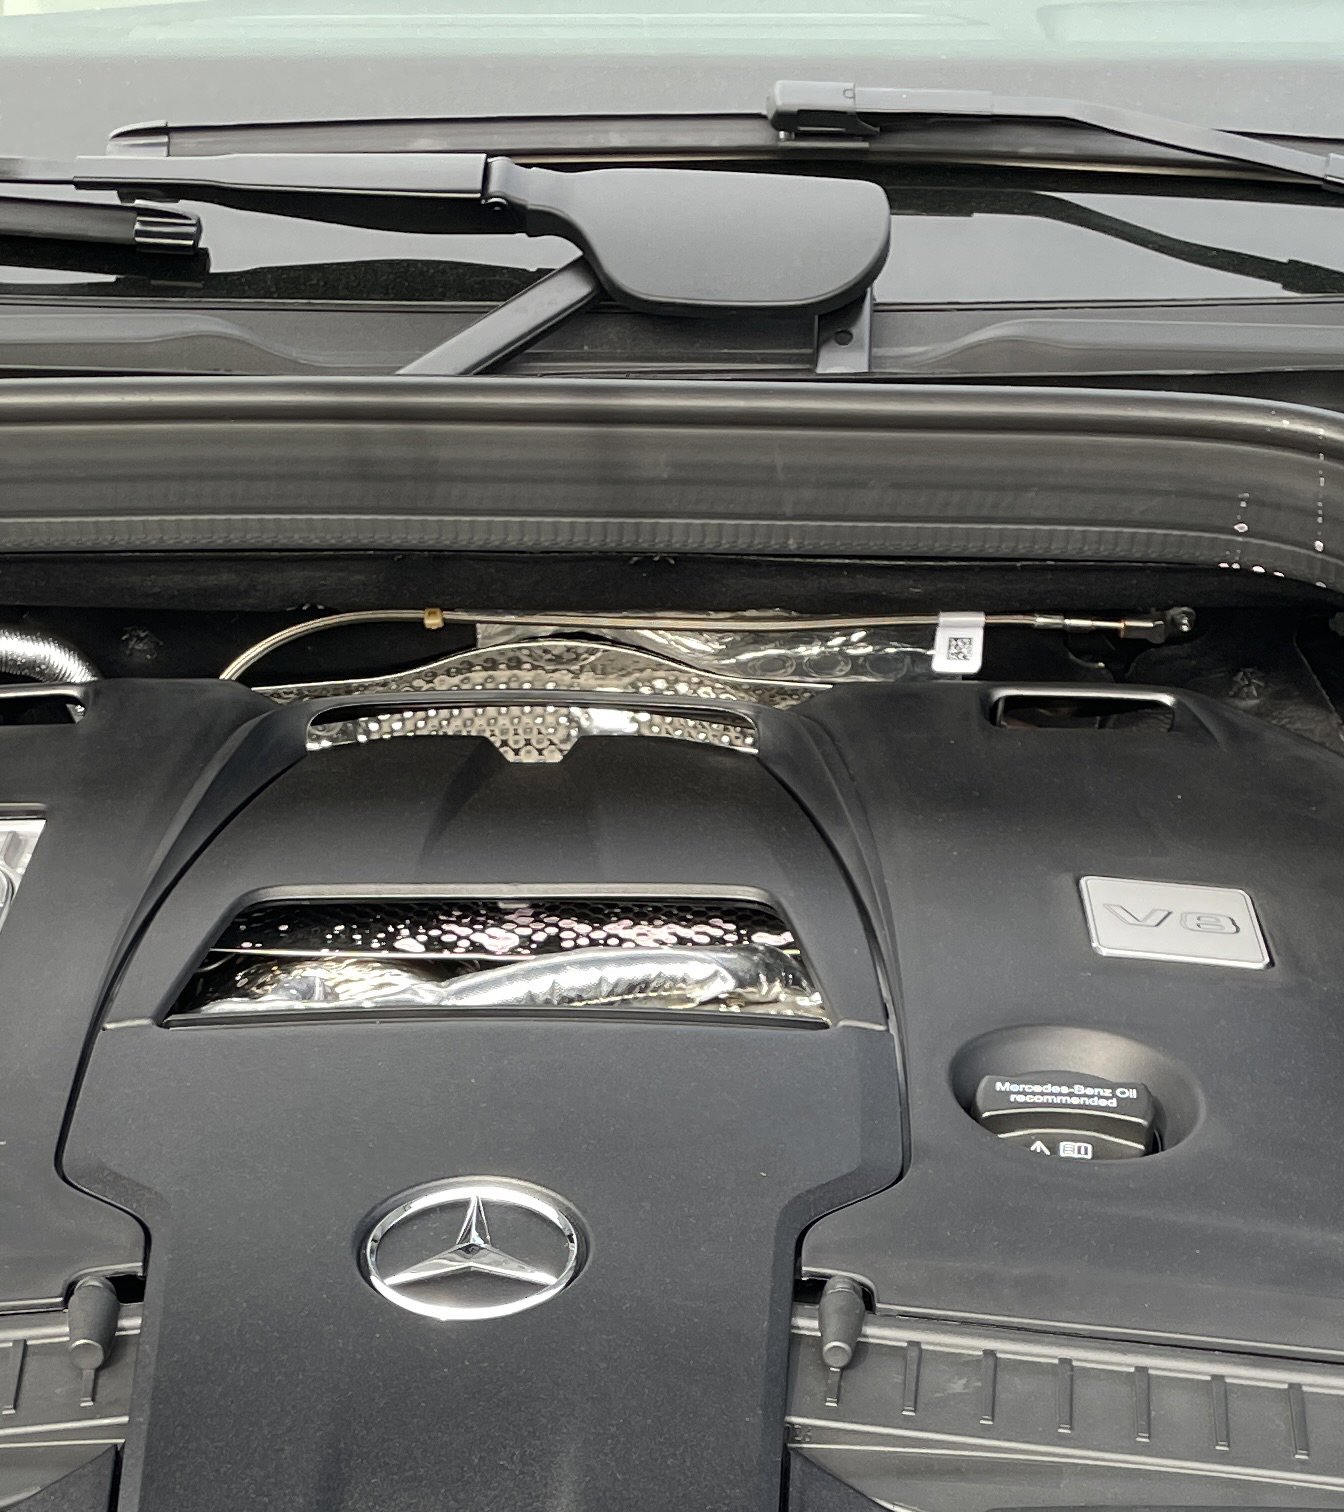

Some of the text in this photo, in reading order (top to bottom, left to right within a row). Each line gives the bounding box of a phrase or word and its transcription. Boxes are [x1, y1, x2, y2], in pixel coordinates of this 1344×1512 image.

[1102, 903, 1241, 935] V8
[995, 1081, 1138, 1099] Mercedes-Benz Oil
[1009, 1093, 1118, 1108] recommended
